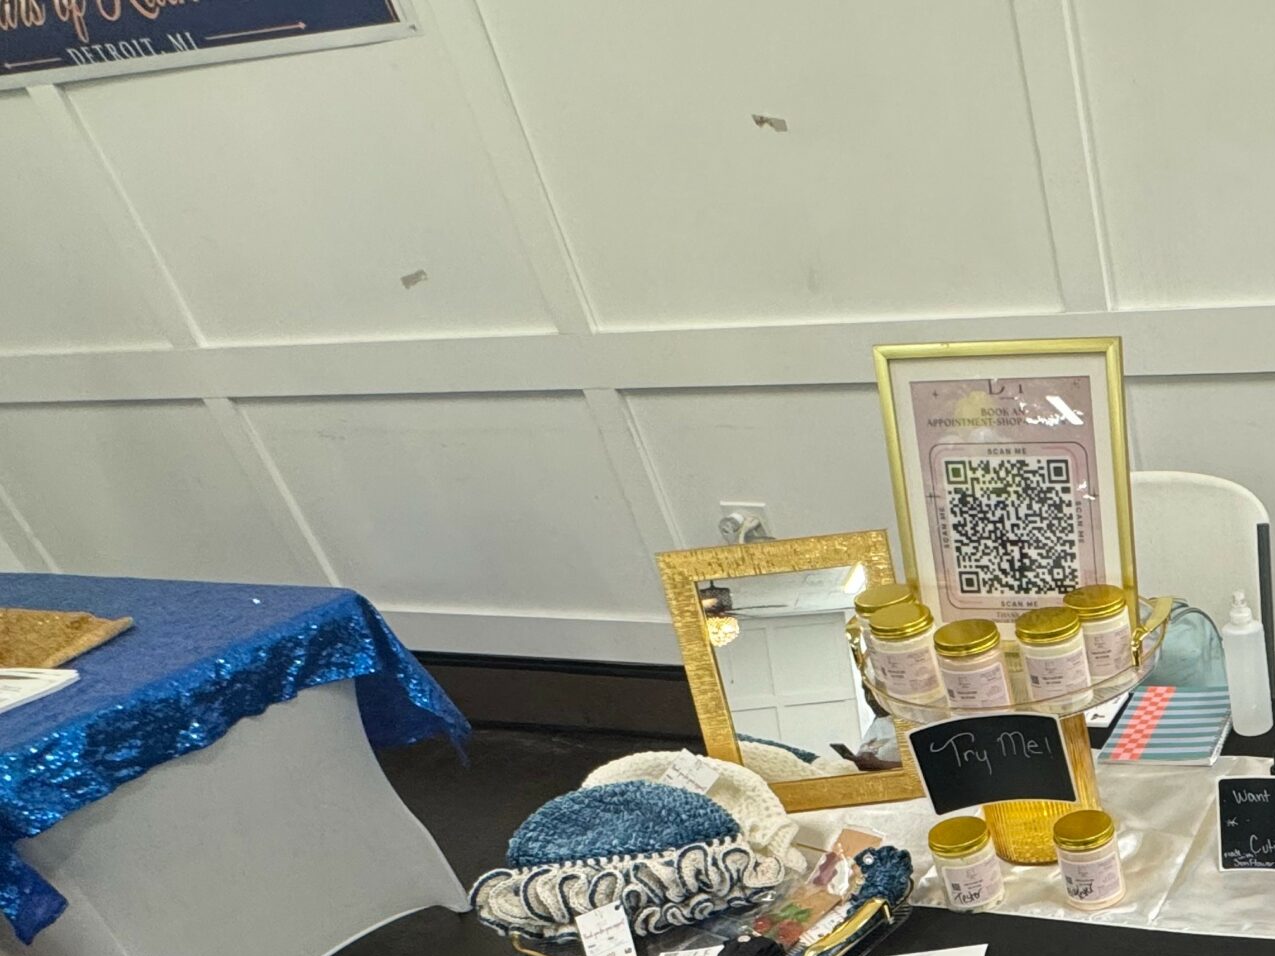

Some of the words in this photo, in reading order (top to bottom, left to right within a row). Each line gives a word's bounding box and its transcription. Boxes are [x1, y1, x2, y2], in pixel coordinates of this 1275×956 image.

[167, 32, 199, 53] MI
[1075, 501, 1083, 527] SCAN
[930, 732, 992, 776] Try
[1232, 788, 1271, 804] Want
